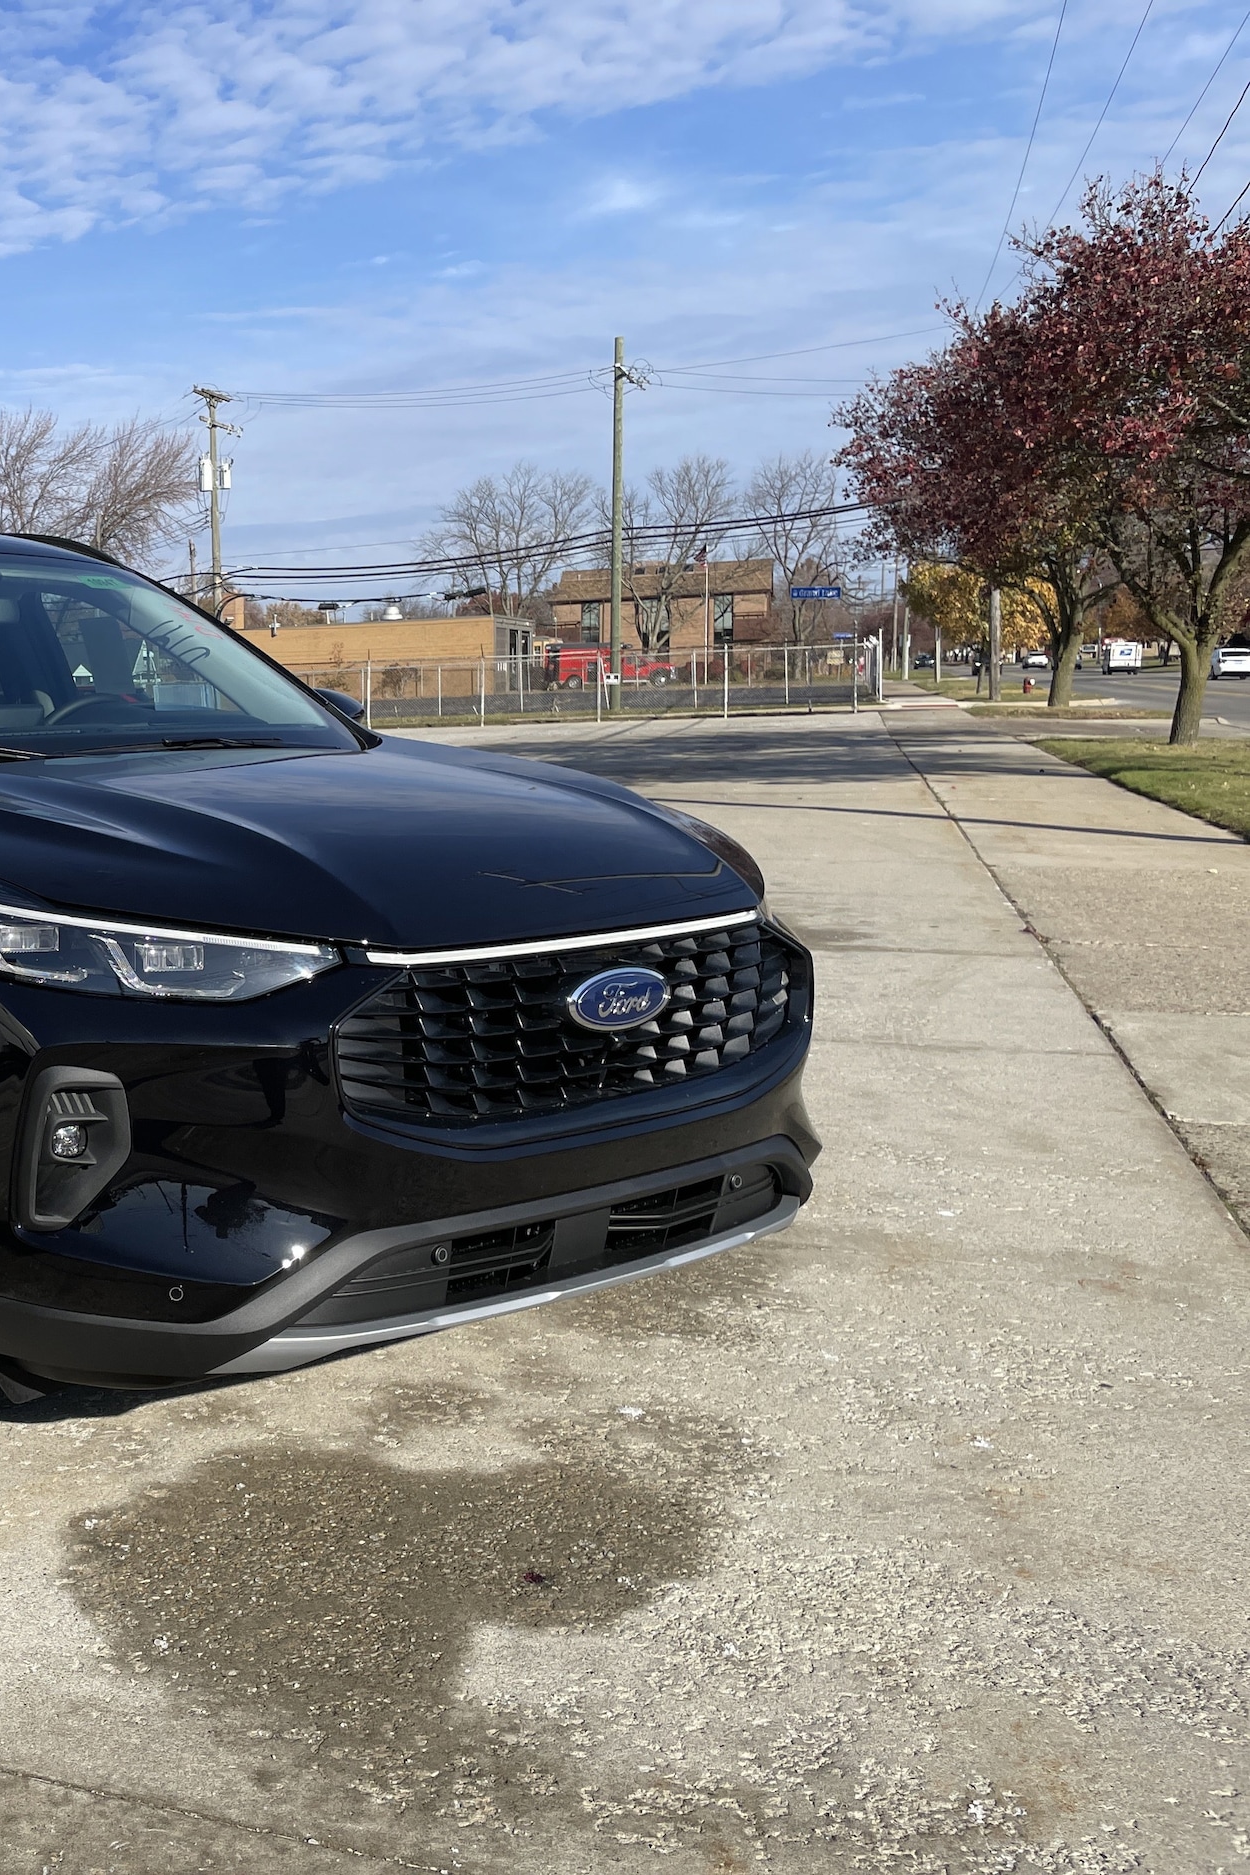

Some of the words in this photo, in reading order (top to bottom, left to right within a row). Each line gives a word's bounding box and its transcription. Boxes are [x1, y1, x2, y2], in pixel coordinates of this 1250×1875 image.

[799, 589, 820, 597] Grand
[821, 589, 838, 597] Lake
[598, 981, 652, 1018] Ford
